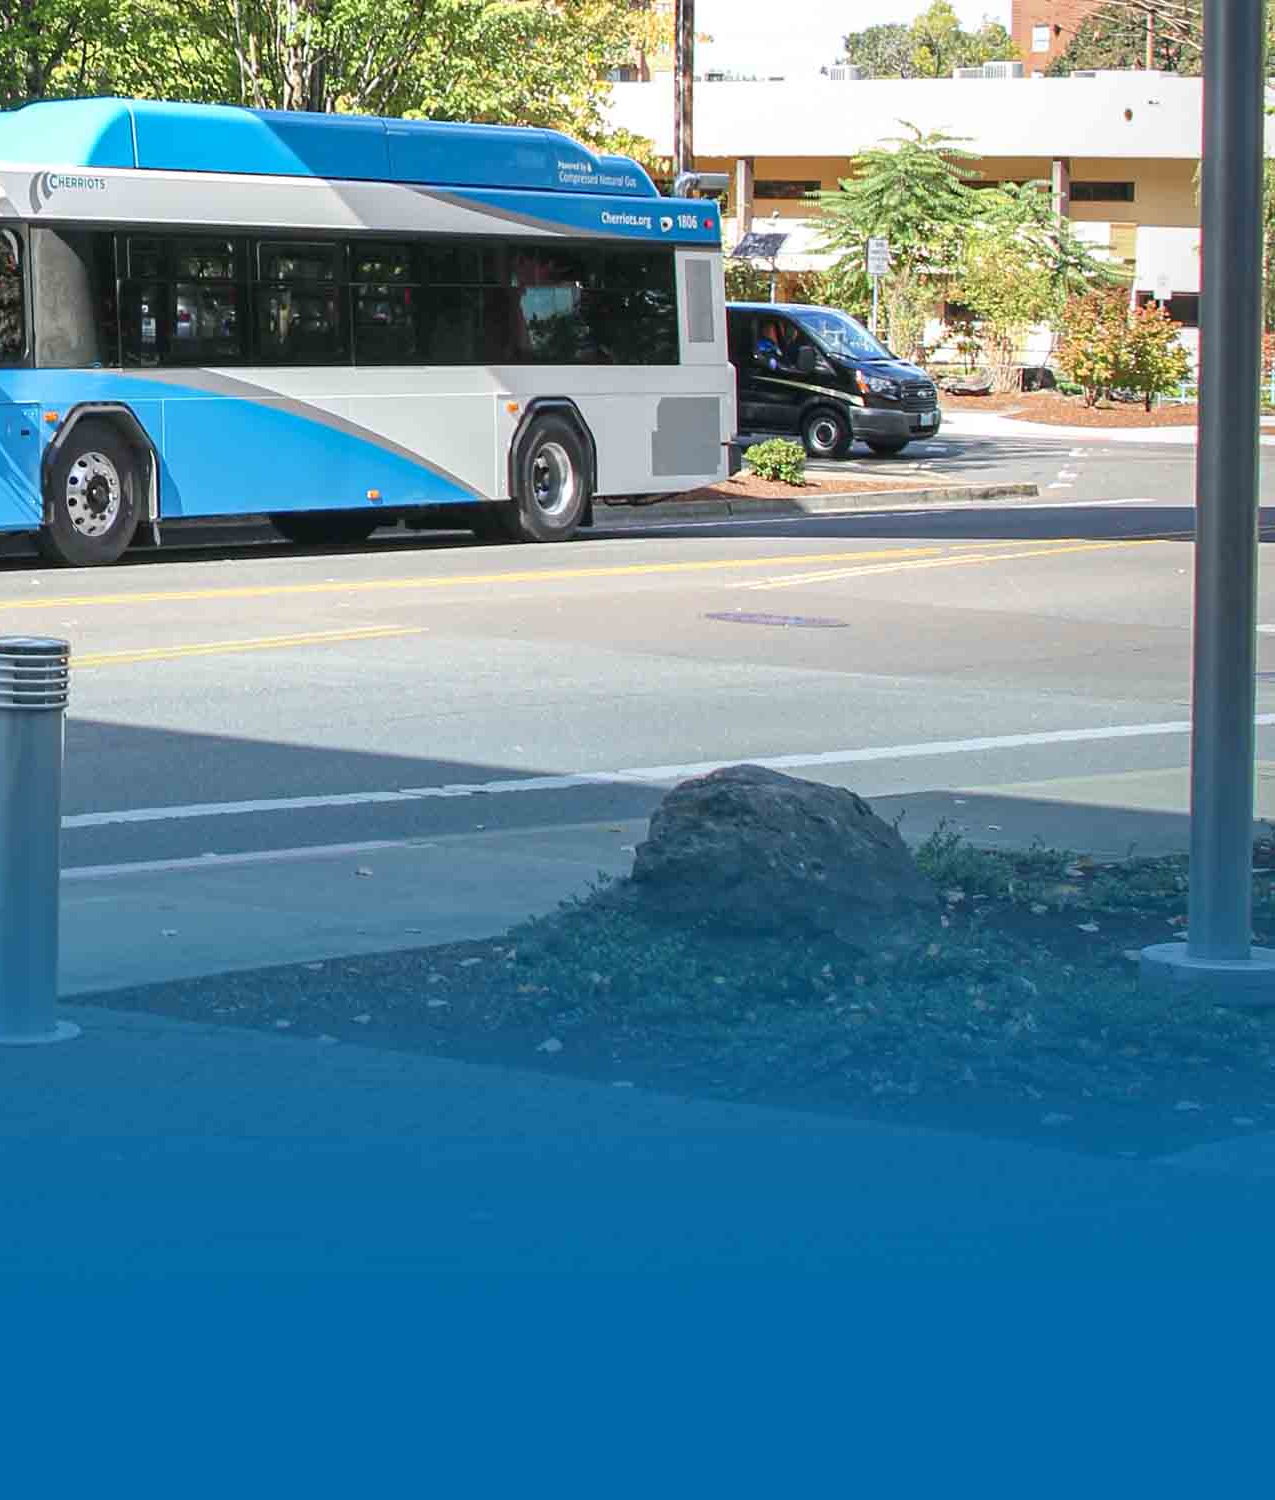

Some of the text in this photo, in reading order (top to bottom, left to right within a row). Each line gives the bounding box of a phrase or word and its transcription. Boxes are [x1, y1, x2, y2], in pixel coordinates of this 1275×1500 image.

[50, 174, 106, 190] CHERRIOTS
[601, 211, 651, 230] Cherriots.org
[677, 215, 698, 229] 1806
